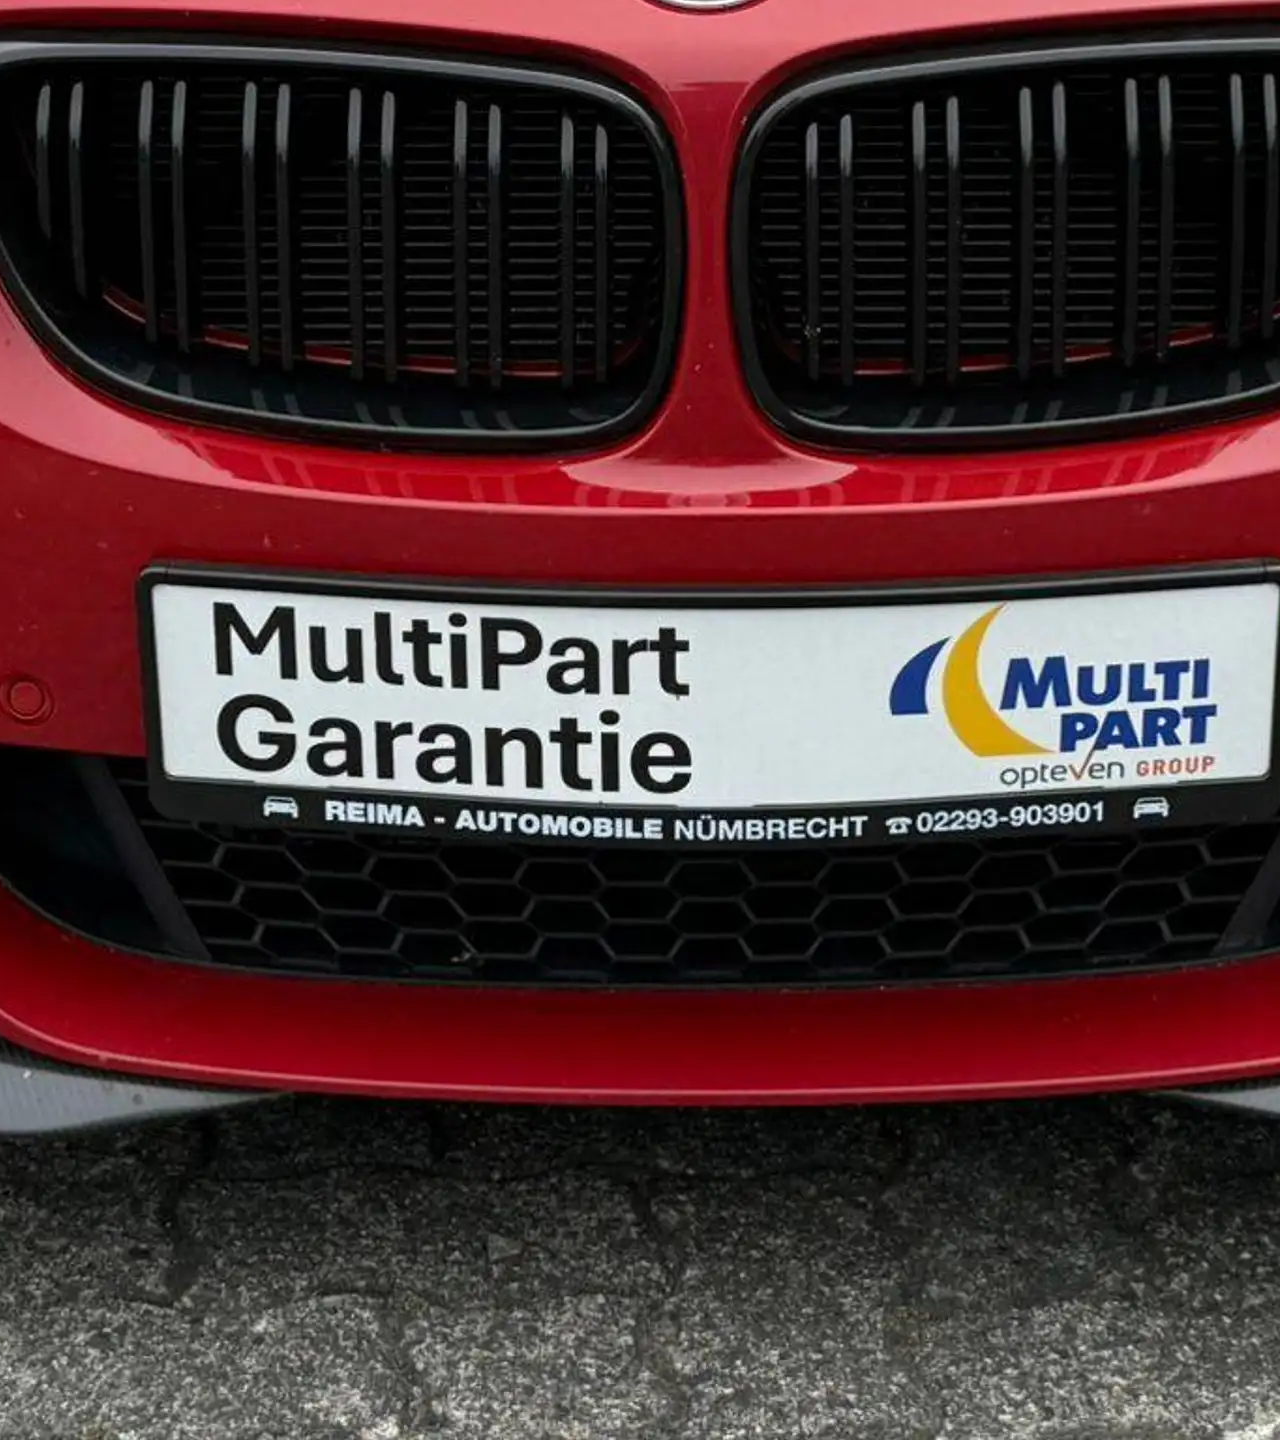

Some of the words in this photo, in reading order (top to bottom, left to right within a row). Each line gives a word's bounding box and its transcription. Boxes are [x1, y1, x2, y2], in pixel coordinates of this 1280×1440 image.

[213, 601, 690, 698] MultiPart
[216, 693, 693, 794] Garantie
[1059, 704, 1218, 753] PART
[999, 746, 1126, 789] opteven
[1135, 754, 1216, 778] GROUP
[325, 800, 424, 827] REIMA
[454, 808, 664, 840] AUTOMOBILE
[673, 812, 868, 841] NÜMBRECHT
[916, 800, 1106, 834] 02293-903901
